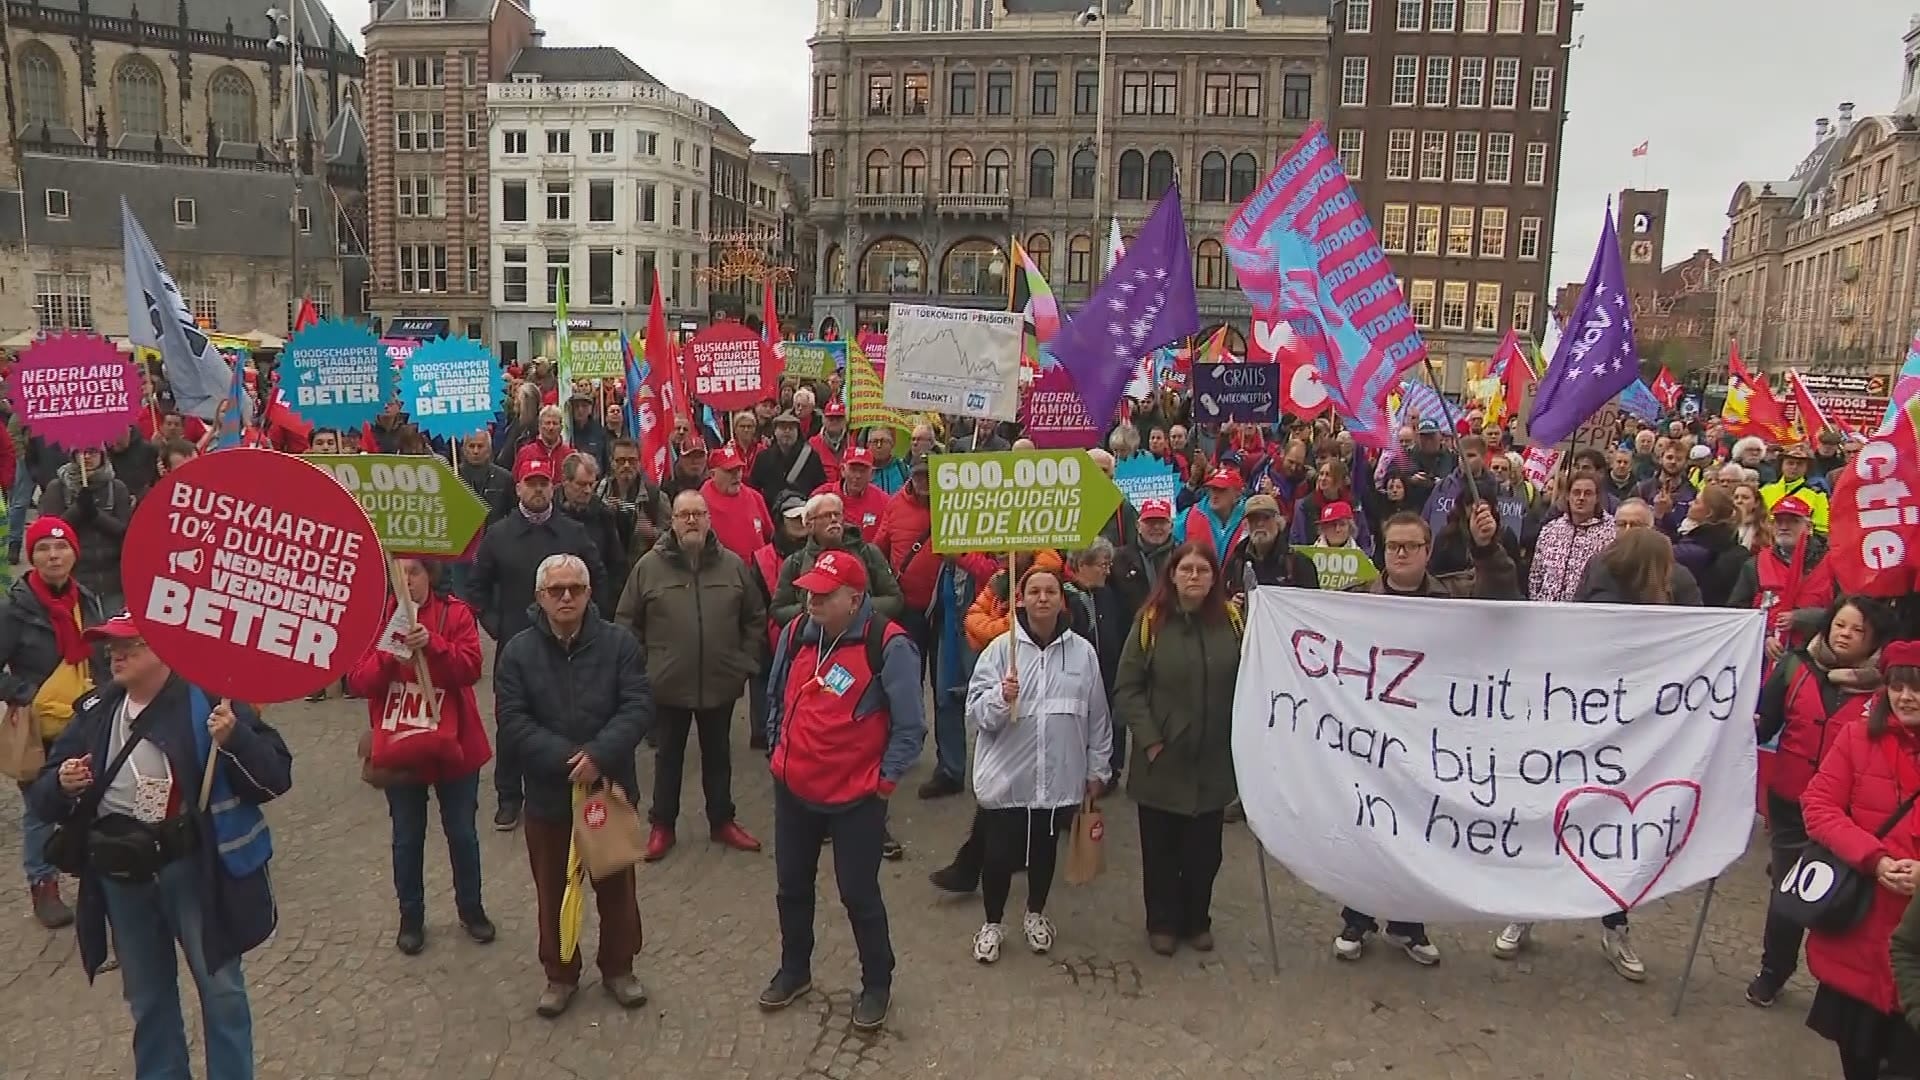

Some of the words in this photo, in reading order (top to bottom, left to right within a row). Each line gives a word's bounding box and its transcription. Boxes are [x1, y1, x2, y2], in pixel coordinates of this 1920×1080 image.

[916, 309, 968, 321] TOEKOMSTIG
[293, 346, 378, 360] BOODSCHAPPEN
[570, 340, 622, 353] 600.00
[693, 340, 760, 353] BUSKAARTJE
[293, 356, 378, 368] ONBETAALBAAR
[318, 365, 378, 375] NEDERLAND
[412, 360, 489, 373] BOODSCHAPPEN
[21, 364, 124, 384] NEDERLAND
[318, 373, 378, 385] VERDIENT
[413, 368, 490, 381] ONBETAALBAAR
[695, 375, 762, 394] BETER
[1223, 367, 1266, 387] GRATIS
[22, 378, 125, 399] KAMPIOEN
[297, 384, 380, 406] BETER
[27, 393, 129, 413] FLEXWERK
[416, 394, 491, 416] BETER
[1814, 397, 1868, 410] OTDOGS
[317, 463, 441, 495] 0.000
[937, 456, 1081, 491] 600.000
[355, 494, 446, 514] OUDENS
[938, 488, 1082, 511] HUISHOUDENS
[170, 482, 364, 560] BUSKAARTJE
[387, 514, 448, 539] KOU!
[940, 512, 969, 537] IN
[975, 510, 1012, 535] DE
[1017, 508, 1081, 534] KOU!
[168, 512, 216, 545] 10%
[223, 527, 357, 584] DUURDER
[948, 537, 1004, 547] NEDERLAND
[1312, 552, 1359, 575] 000
[213, 548, 352, 602] NEDERLAND
[210, 567, 347, 625] VERDIENT
[145, 575, 339, 670] BETER
[1449, 668, 1516, 721] uit
[1544, 672, 1636, 726] het
[1655, 665, 1738, 721] oog
[1267, 690, 1408, 769] maar
[1519, 745, 1627, 786] ons
[1355, 783, 1398, 836] in
[1425, 794, 1523, 858] het
[1555, 806, 1682, 860] hart
